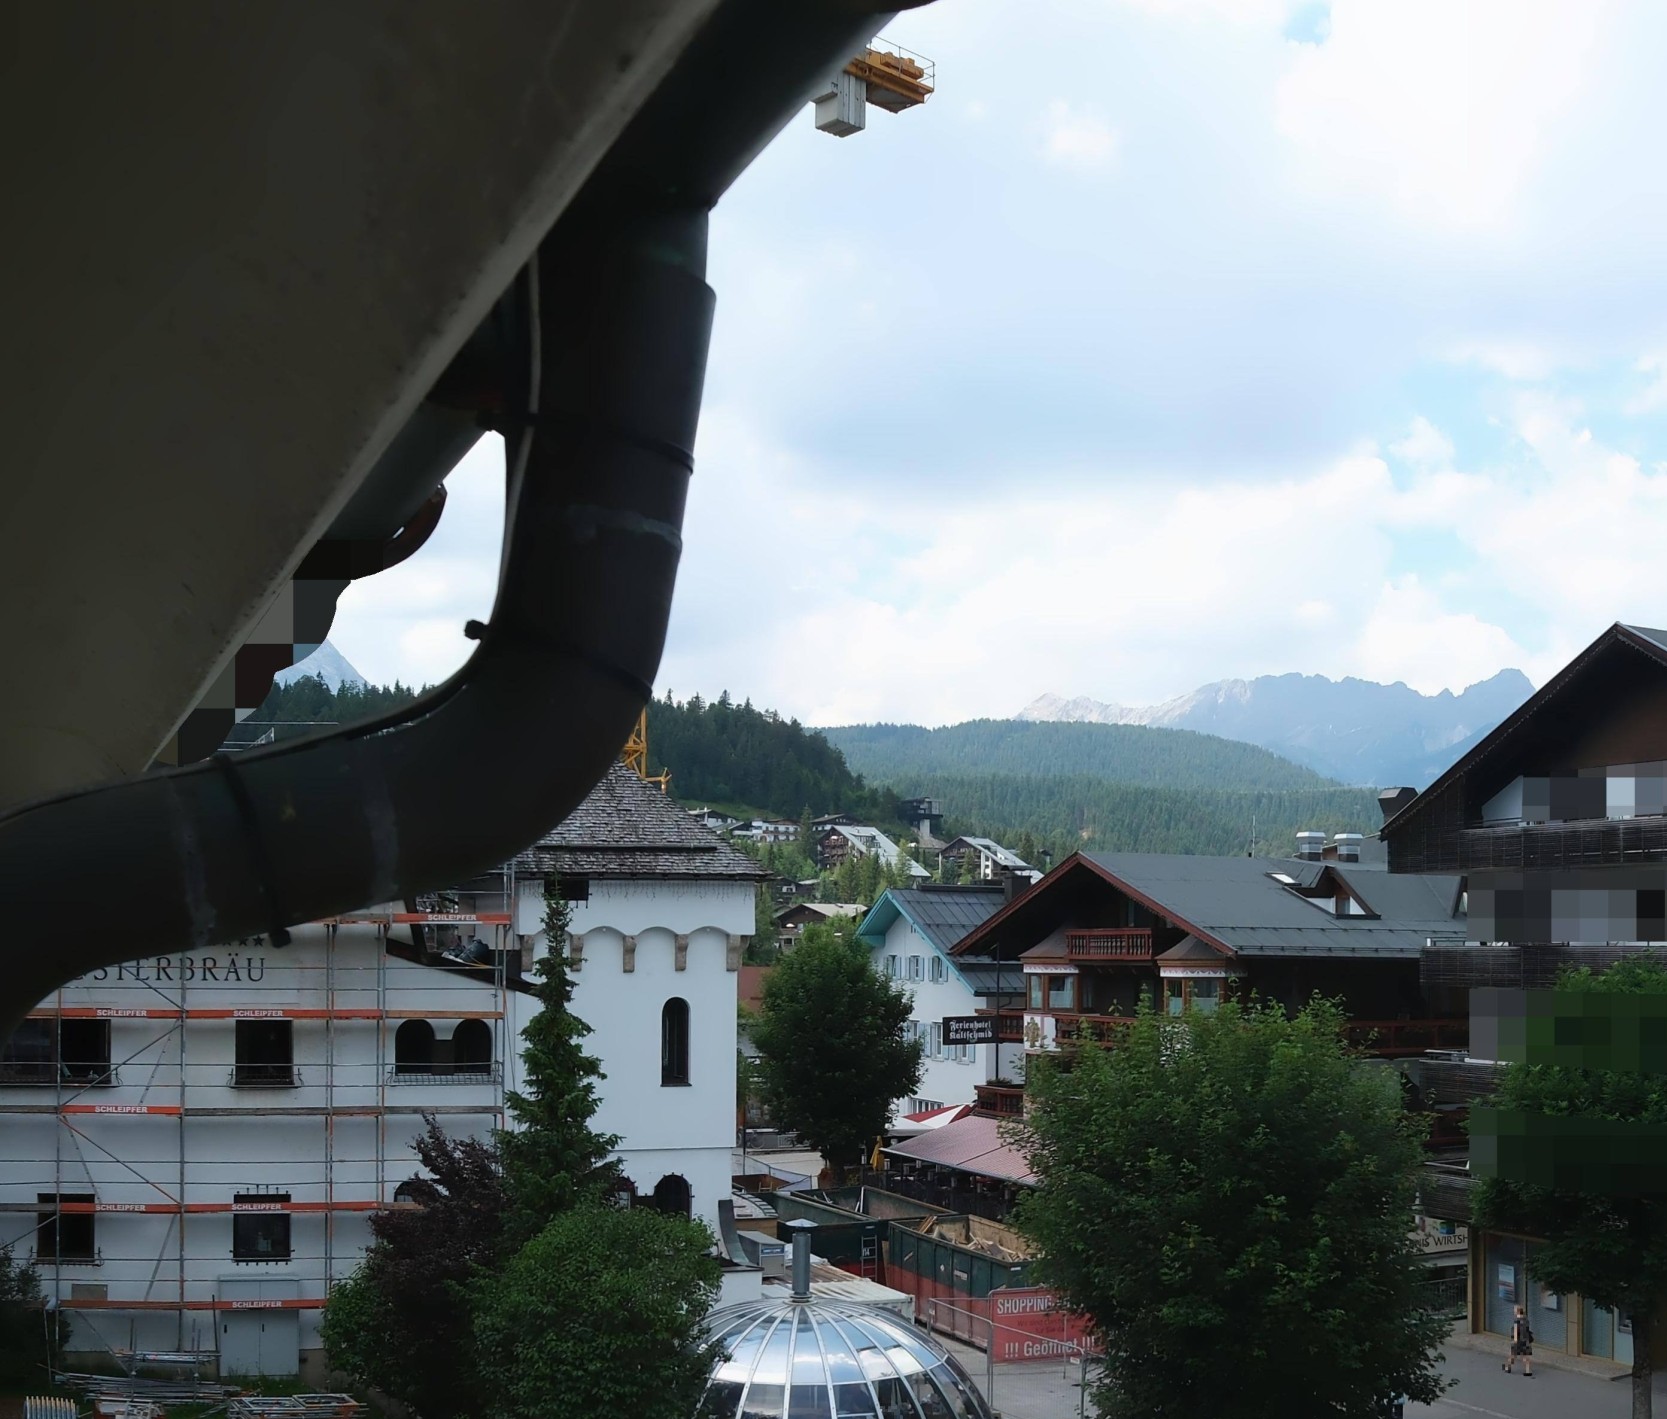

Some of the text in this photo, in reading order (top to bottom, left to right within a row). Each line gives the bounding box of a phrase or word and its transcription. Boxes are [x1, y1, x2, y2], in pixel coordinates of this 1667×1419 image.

[428, 914, 477, 923] SCHLEIPFER
[96, 1009, 147, 1018] SCHLEIPFER
[233, 1009, 283, 1018] SCHLEIPFER
[95, 1105, 148, 1115] SCHLEIPFER
[95, 1203, 146, 1213] SCHLEIPFER
[231, 1202, 282, 1212] SCHLEIPFER
[232, 1299, 282, 1309] SCHLEIPFER
